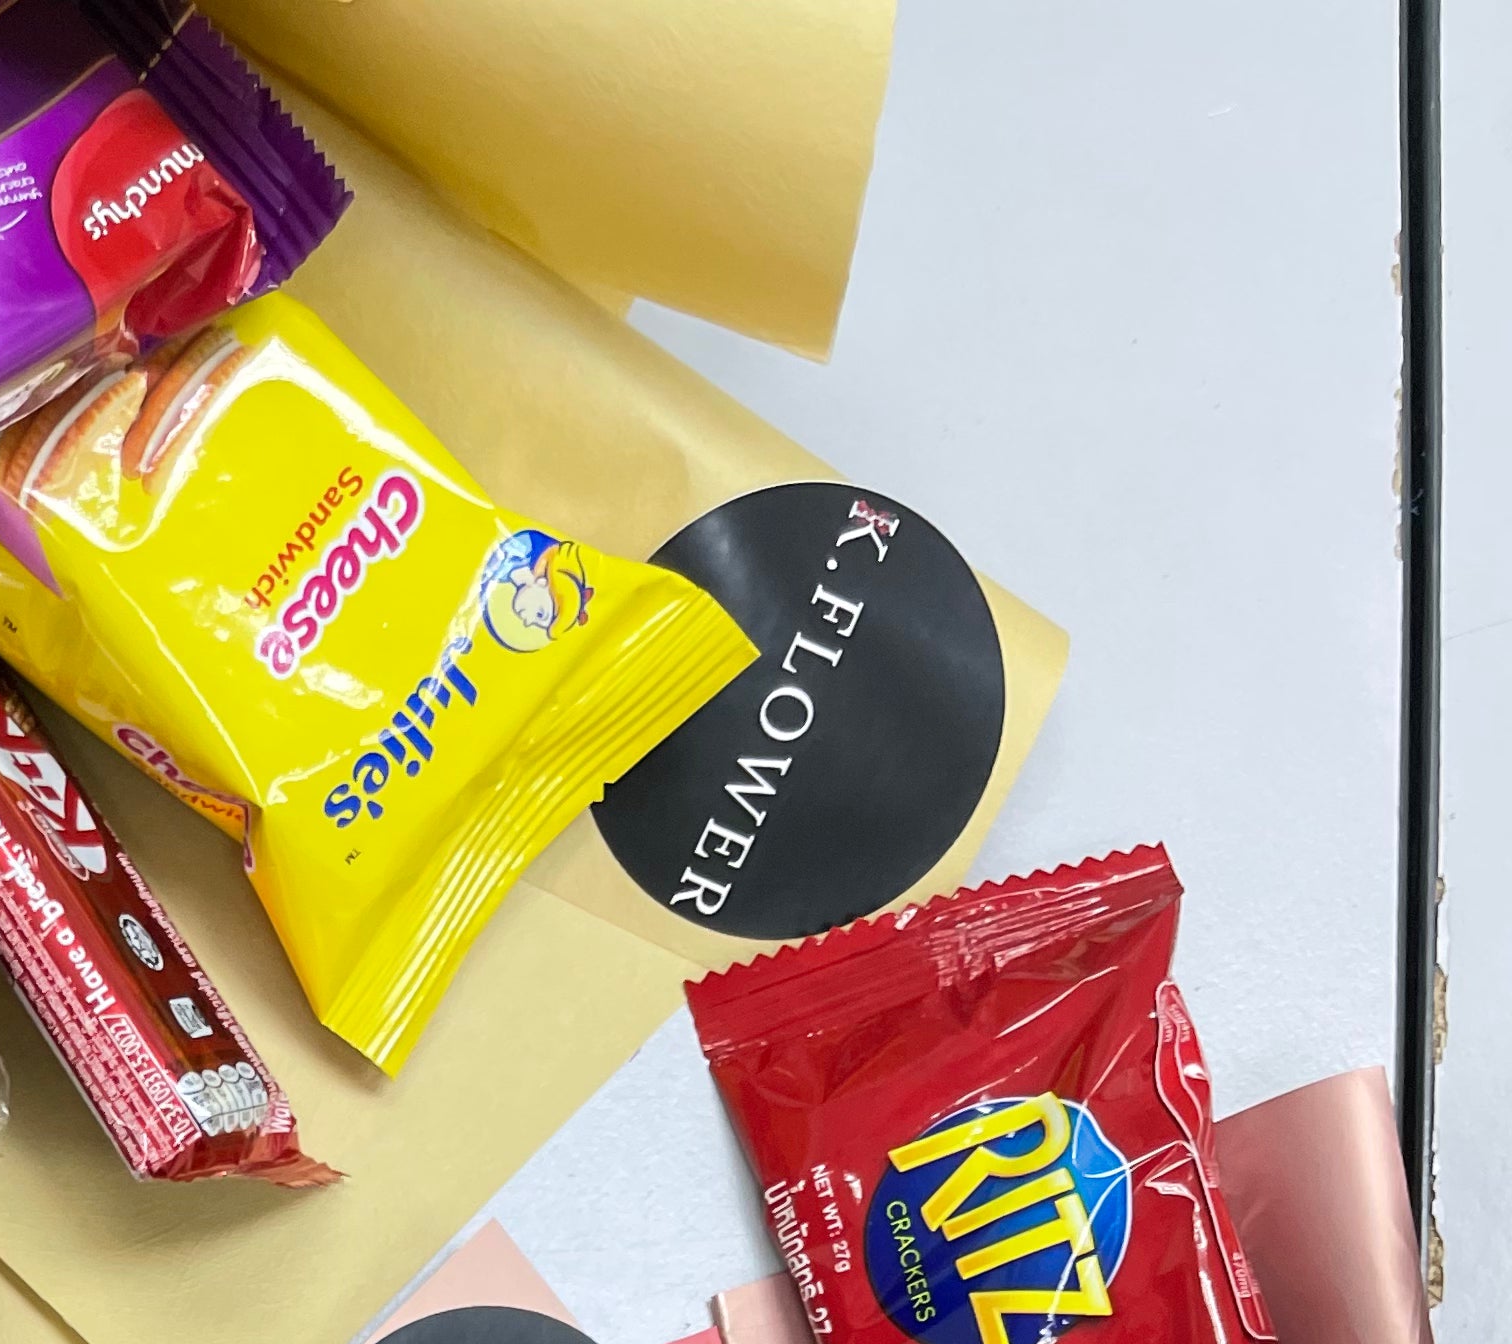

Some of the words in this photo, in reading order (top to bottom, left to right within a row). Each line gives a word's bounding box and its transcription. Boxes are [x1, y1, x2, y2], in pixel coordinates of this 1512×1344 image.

[245, 466, 363, 609] Sandwich
[260, 474, 419, 673] Cheese
[324, 634, 478, 829] Julie's
[670, 500, 900, 915] K.FLOWER
[55, 926, 75, 945] a
[61, 941, 117, 1012] Have
[809, 1163, 835, 1202] NET
[820, 1202, 844, 1237] WT:
[827, 1239, 854, 1273] 27g
[886, 1200, 936, 1323] CRACKERS
